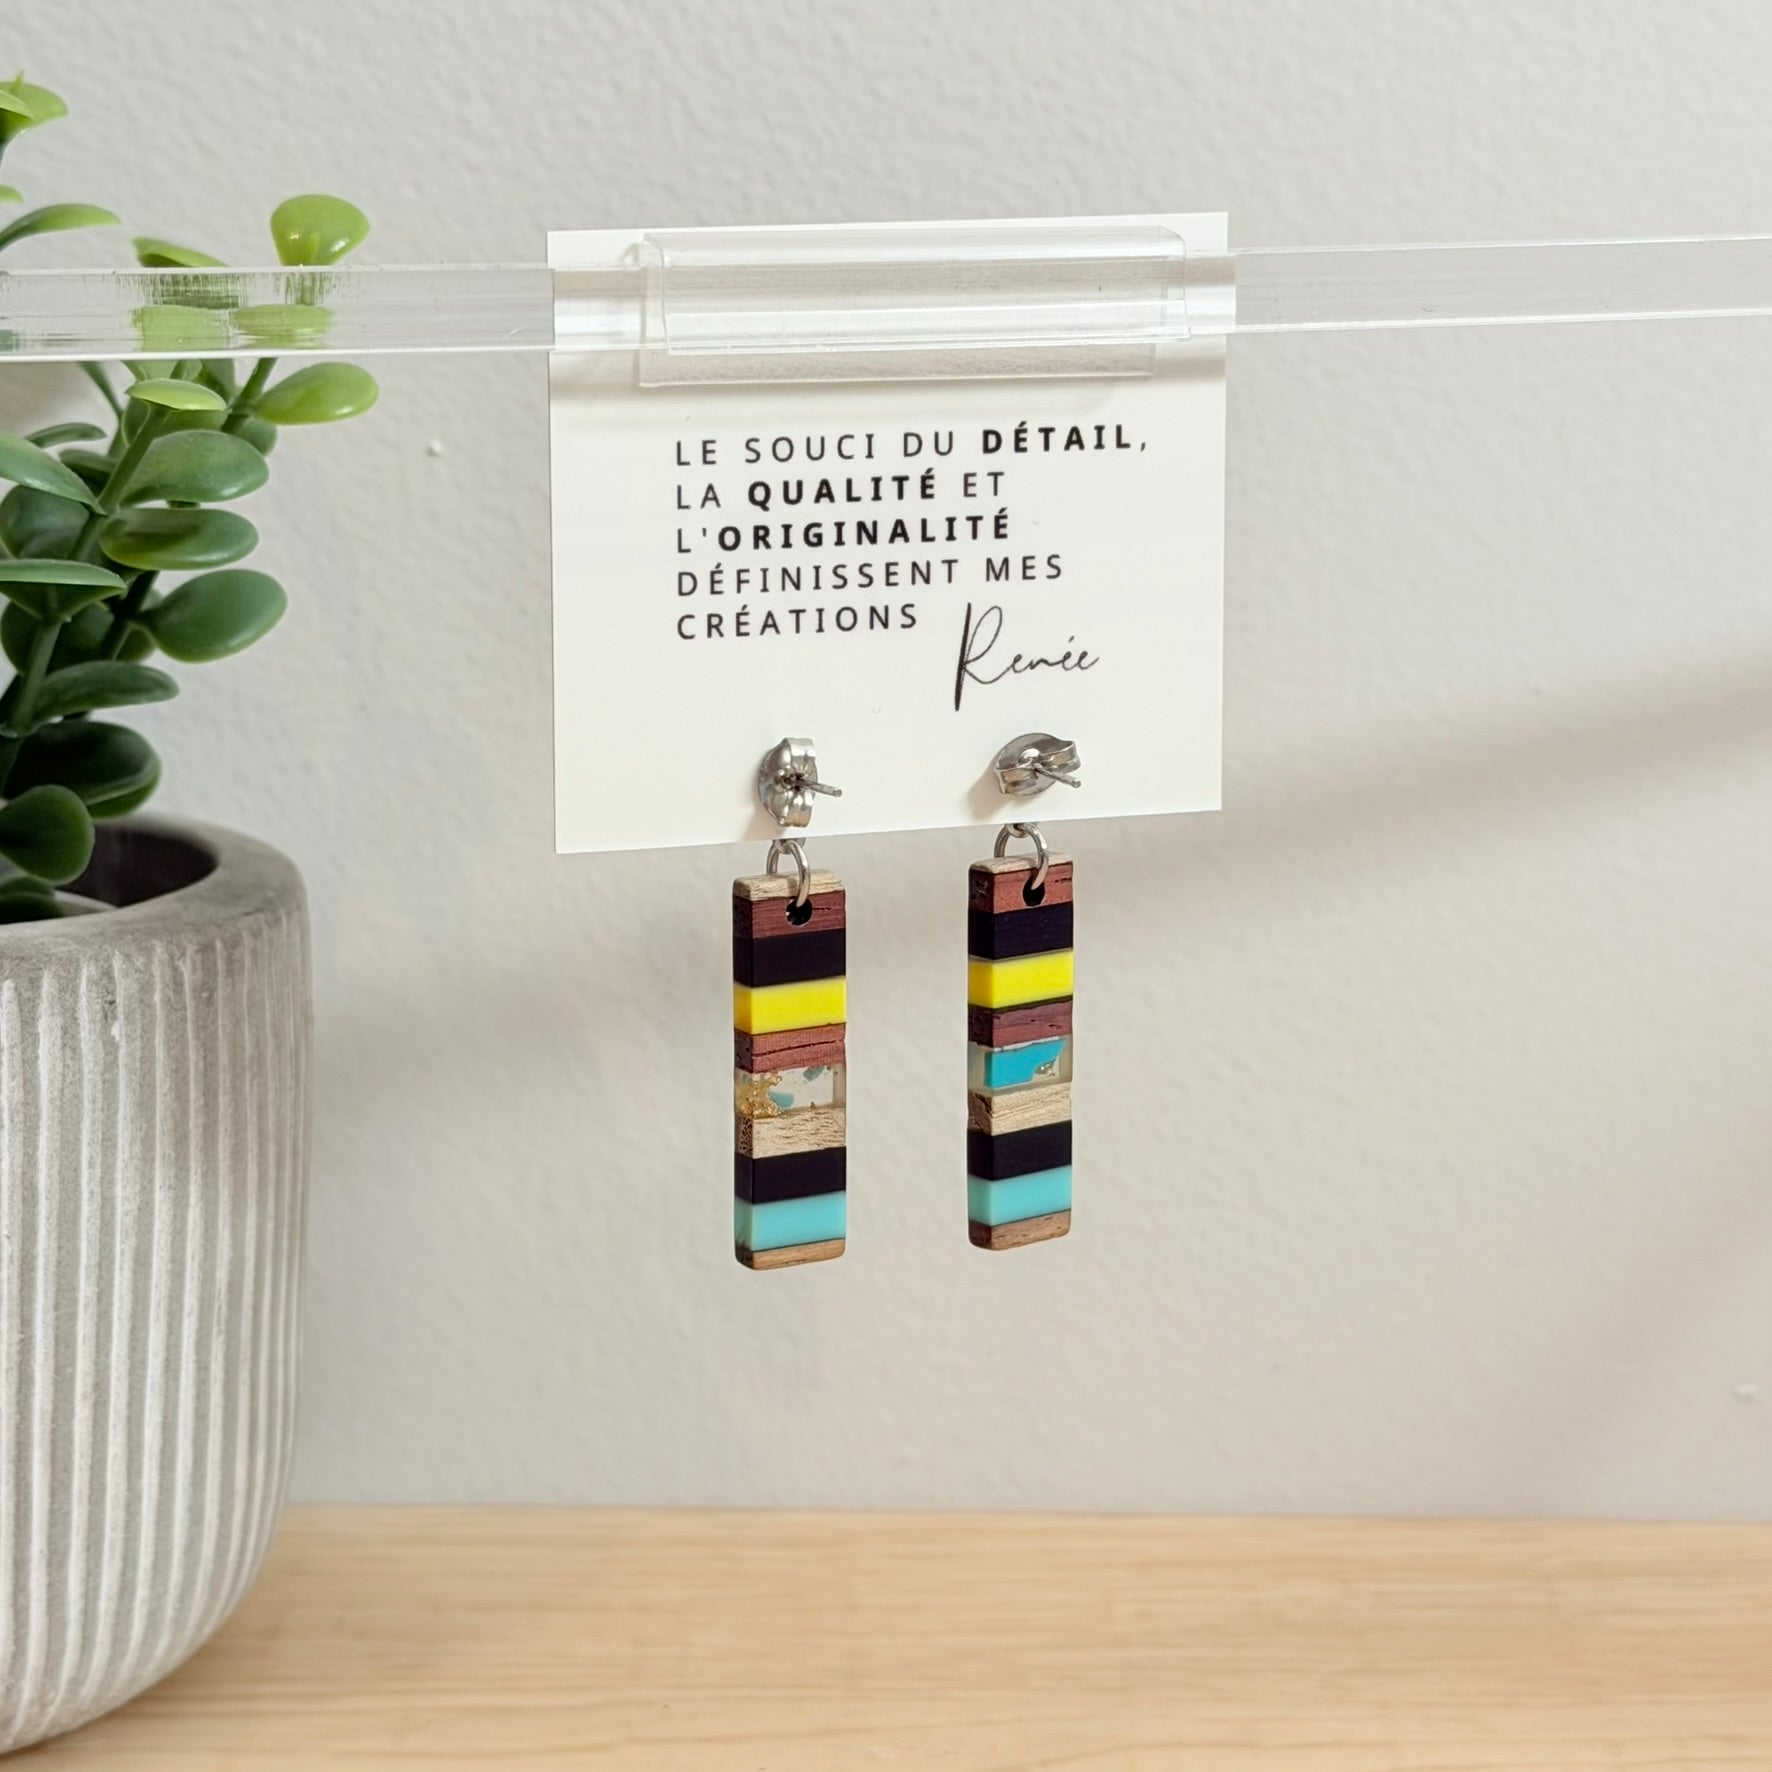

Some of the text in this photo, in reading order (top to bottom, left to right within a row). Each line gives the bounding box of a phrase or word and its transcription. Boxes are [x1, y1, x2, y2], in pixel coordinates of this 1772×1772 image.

[676, 420, 1148, 467] LE SOUCI DU DÉTAIL,
[676, 468, 1005, 512] LA QUALITÉ ET
[676, 508, 1009, 554] L'ORIGINALITÉ
[677, 554, 1062, 597] DÉFINISSENT MES
[677, 603, 917, 640] CRÉATIONS
[954, 602, 1099, 712] Renée
